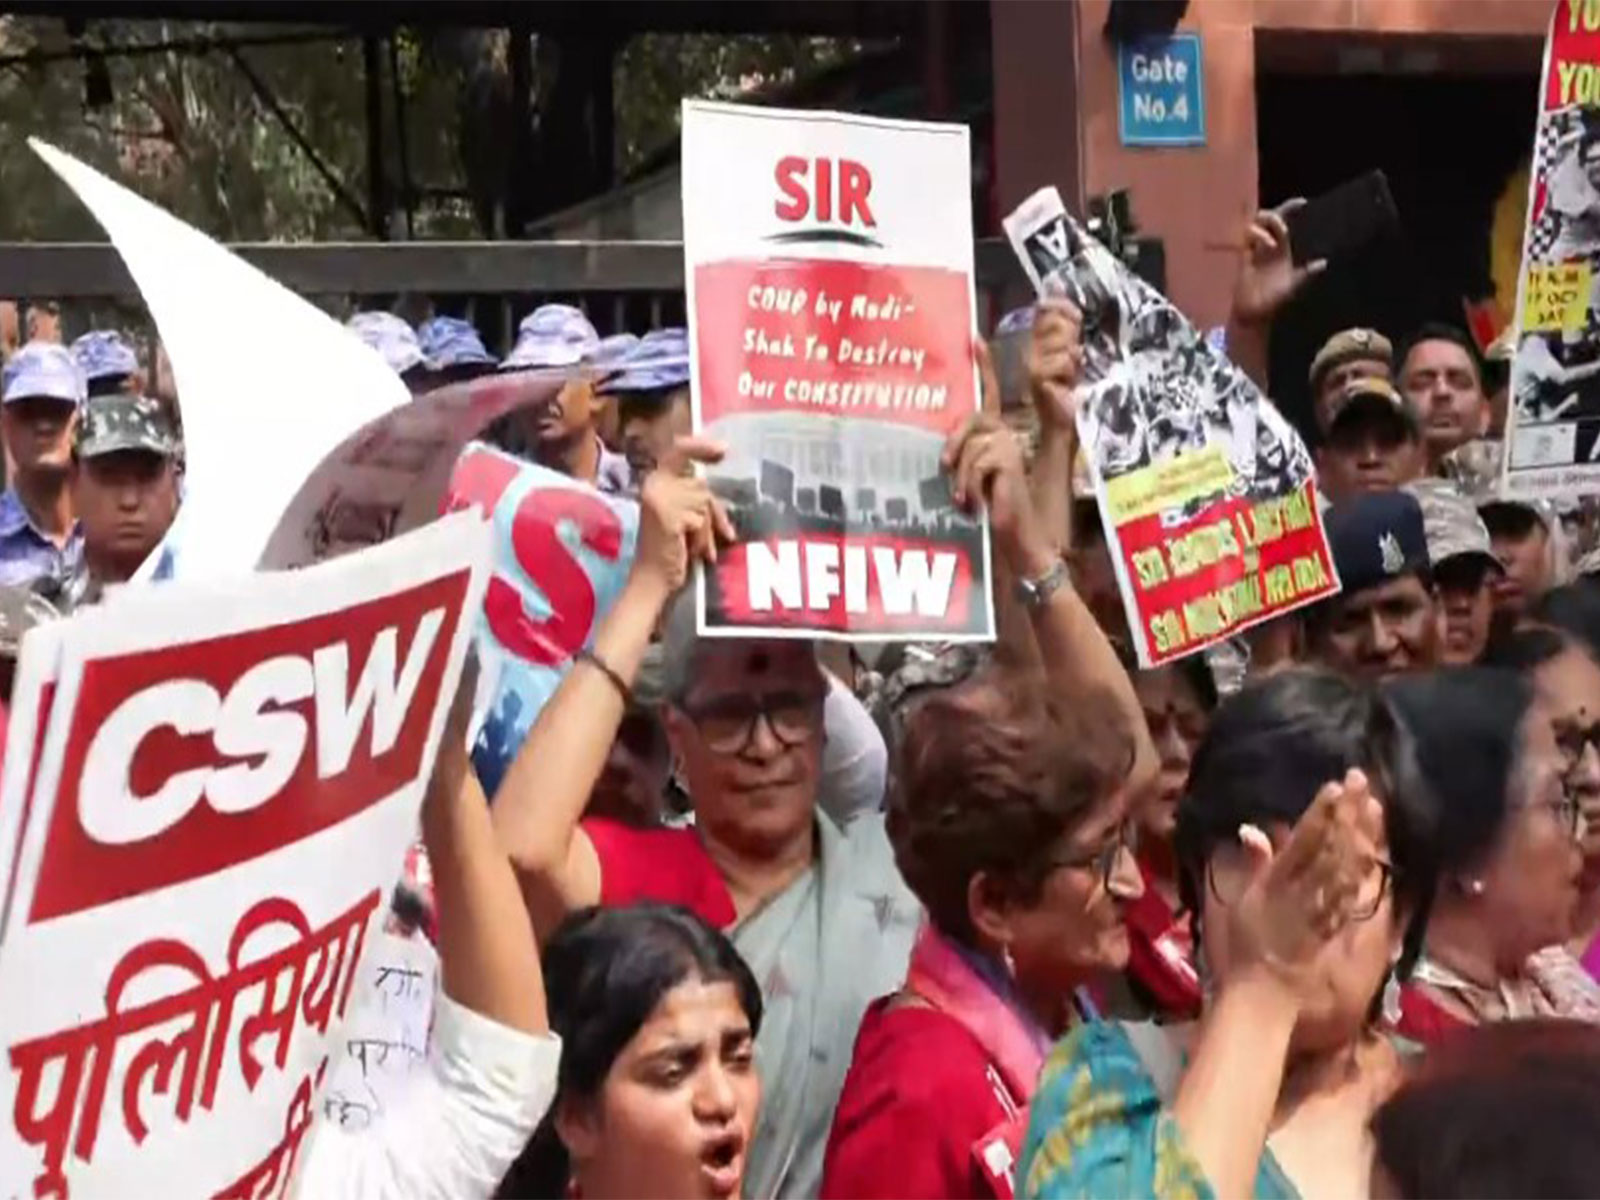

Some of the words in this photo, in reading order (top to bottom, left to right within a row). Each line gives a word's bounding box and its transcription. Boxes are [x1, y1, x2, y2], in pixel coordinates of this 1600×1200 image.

[1132, 54, 1188, 82] Gate
[1133, 93, 1188, 123] No.4
[774, 156, 876, 227] SIR
[748, 284, 808, 316] COUP
[815, 289, 842, 325] by
[838, 337, 925, 373] Destroy
[737, 371, 776, 398] Our
[784, 377, 949, 411] CONSTITUTION
[746, 540, 957, 617] NFIW
[78, 607, 446, 825] CSW
